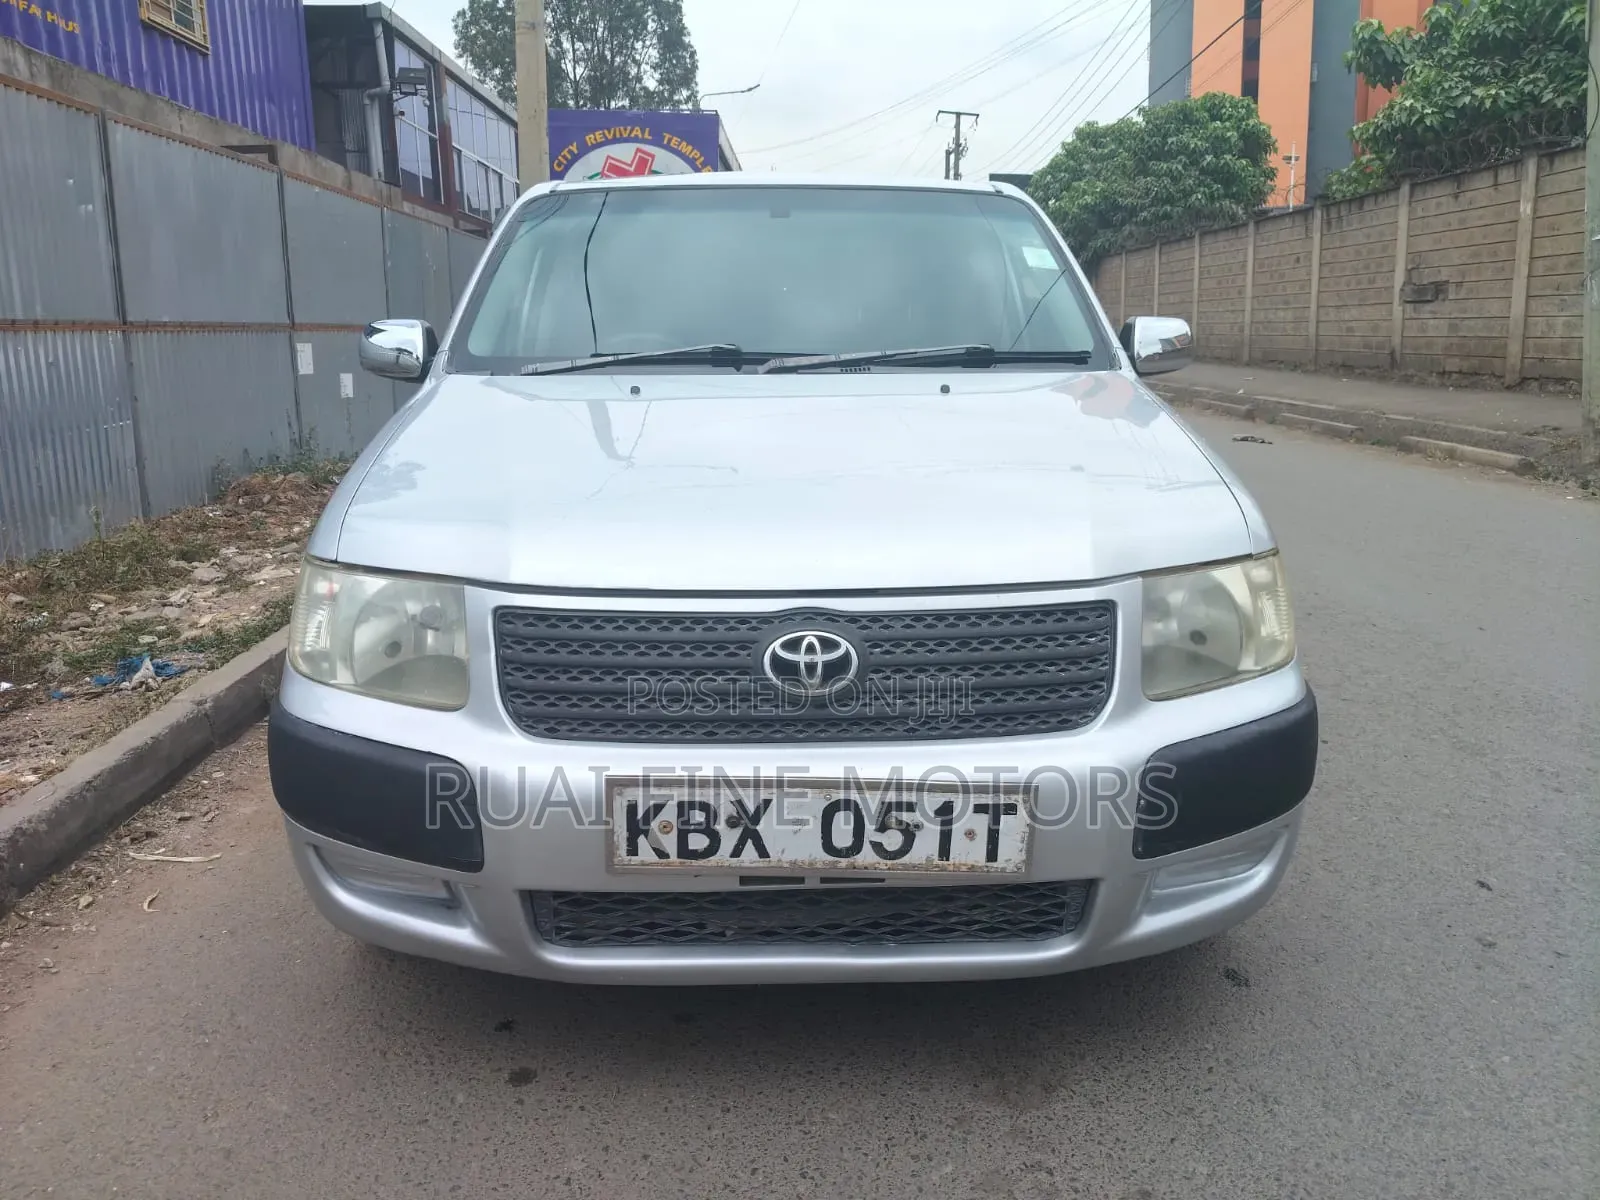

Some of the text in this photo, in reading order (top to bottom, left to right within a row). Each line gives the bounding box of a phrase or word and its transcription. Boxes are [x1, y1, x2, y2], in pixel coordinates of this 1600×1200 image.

[553, 142, 578, 172] CITY
[585, 126, 653, 147] REVIVAL
[625, 798, 1018, 863] KBX 051T
